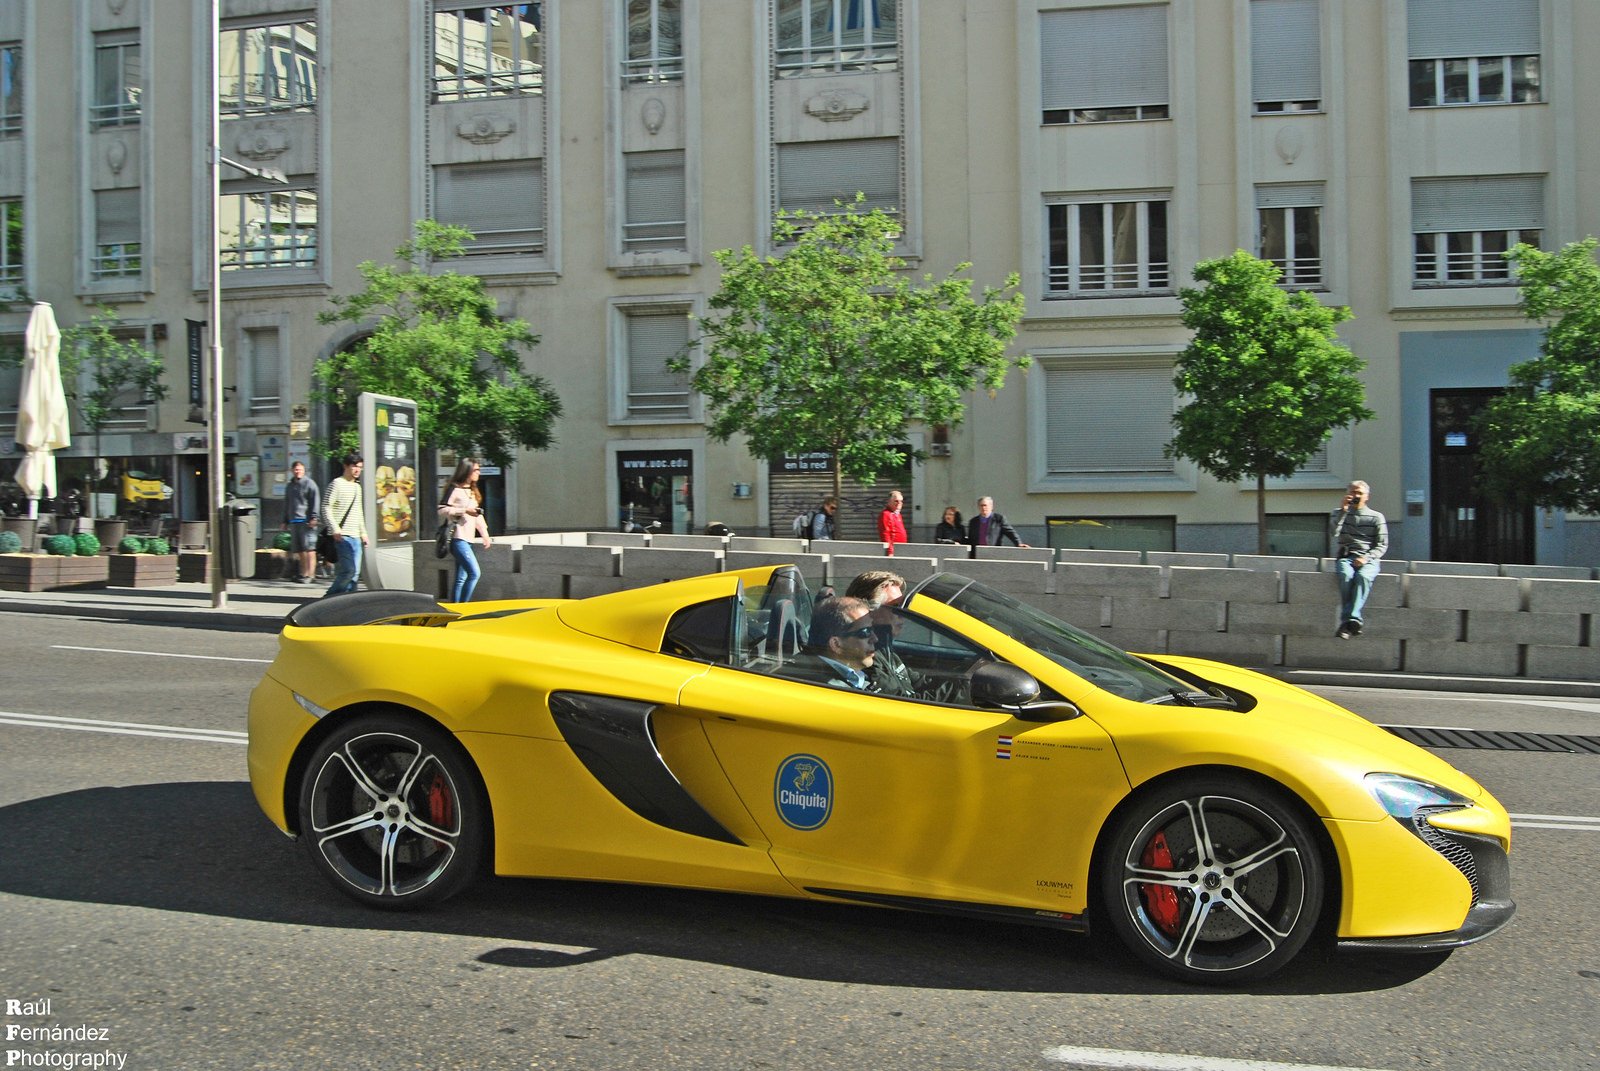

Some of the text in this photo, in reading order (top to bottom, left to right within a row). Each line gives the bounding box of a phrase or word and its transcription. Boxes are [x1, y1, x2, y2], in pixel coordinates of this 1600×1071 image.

[623, 458, 689, 468] www.uoc.edu
[799, 461, 808, 469] la
[810, 461, 827, 469] red
[780, 789, 827, 810] Chiquita
[1036, 880, 1073, 889] LOUWMAN
